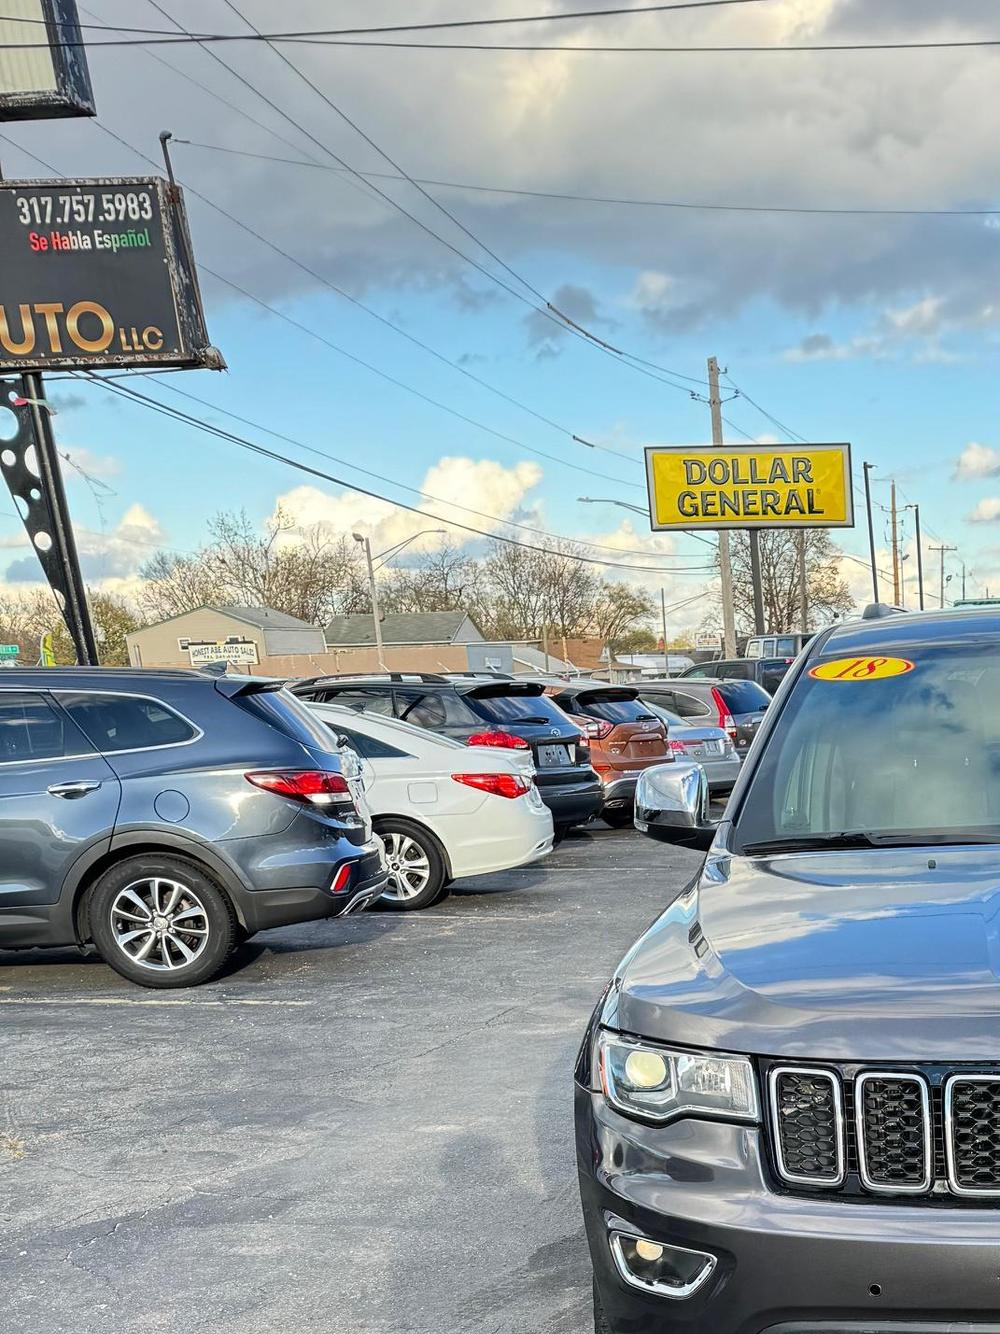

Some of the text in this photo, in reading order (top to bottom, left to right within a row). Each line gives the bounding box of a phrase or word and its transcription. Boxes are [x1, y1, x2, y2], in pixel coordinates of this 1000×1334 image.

[16, 192, 153, 225] 317.757.5983
[29, 228, 151, 252] Se Habla Español
[0, 301, 164, 355] UTO LLC
[683, 457, 813, 486] DOLLAR
[677, 488, 824, 517] GENERAL
[223, 646, 239, 654] AUTO
[832, 658, 888, 679] 18
